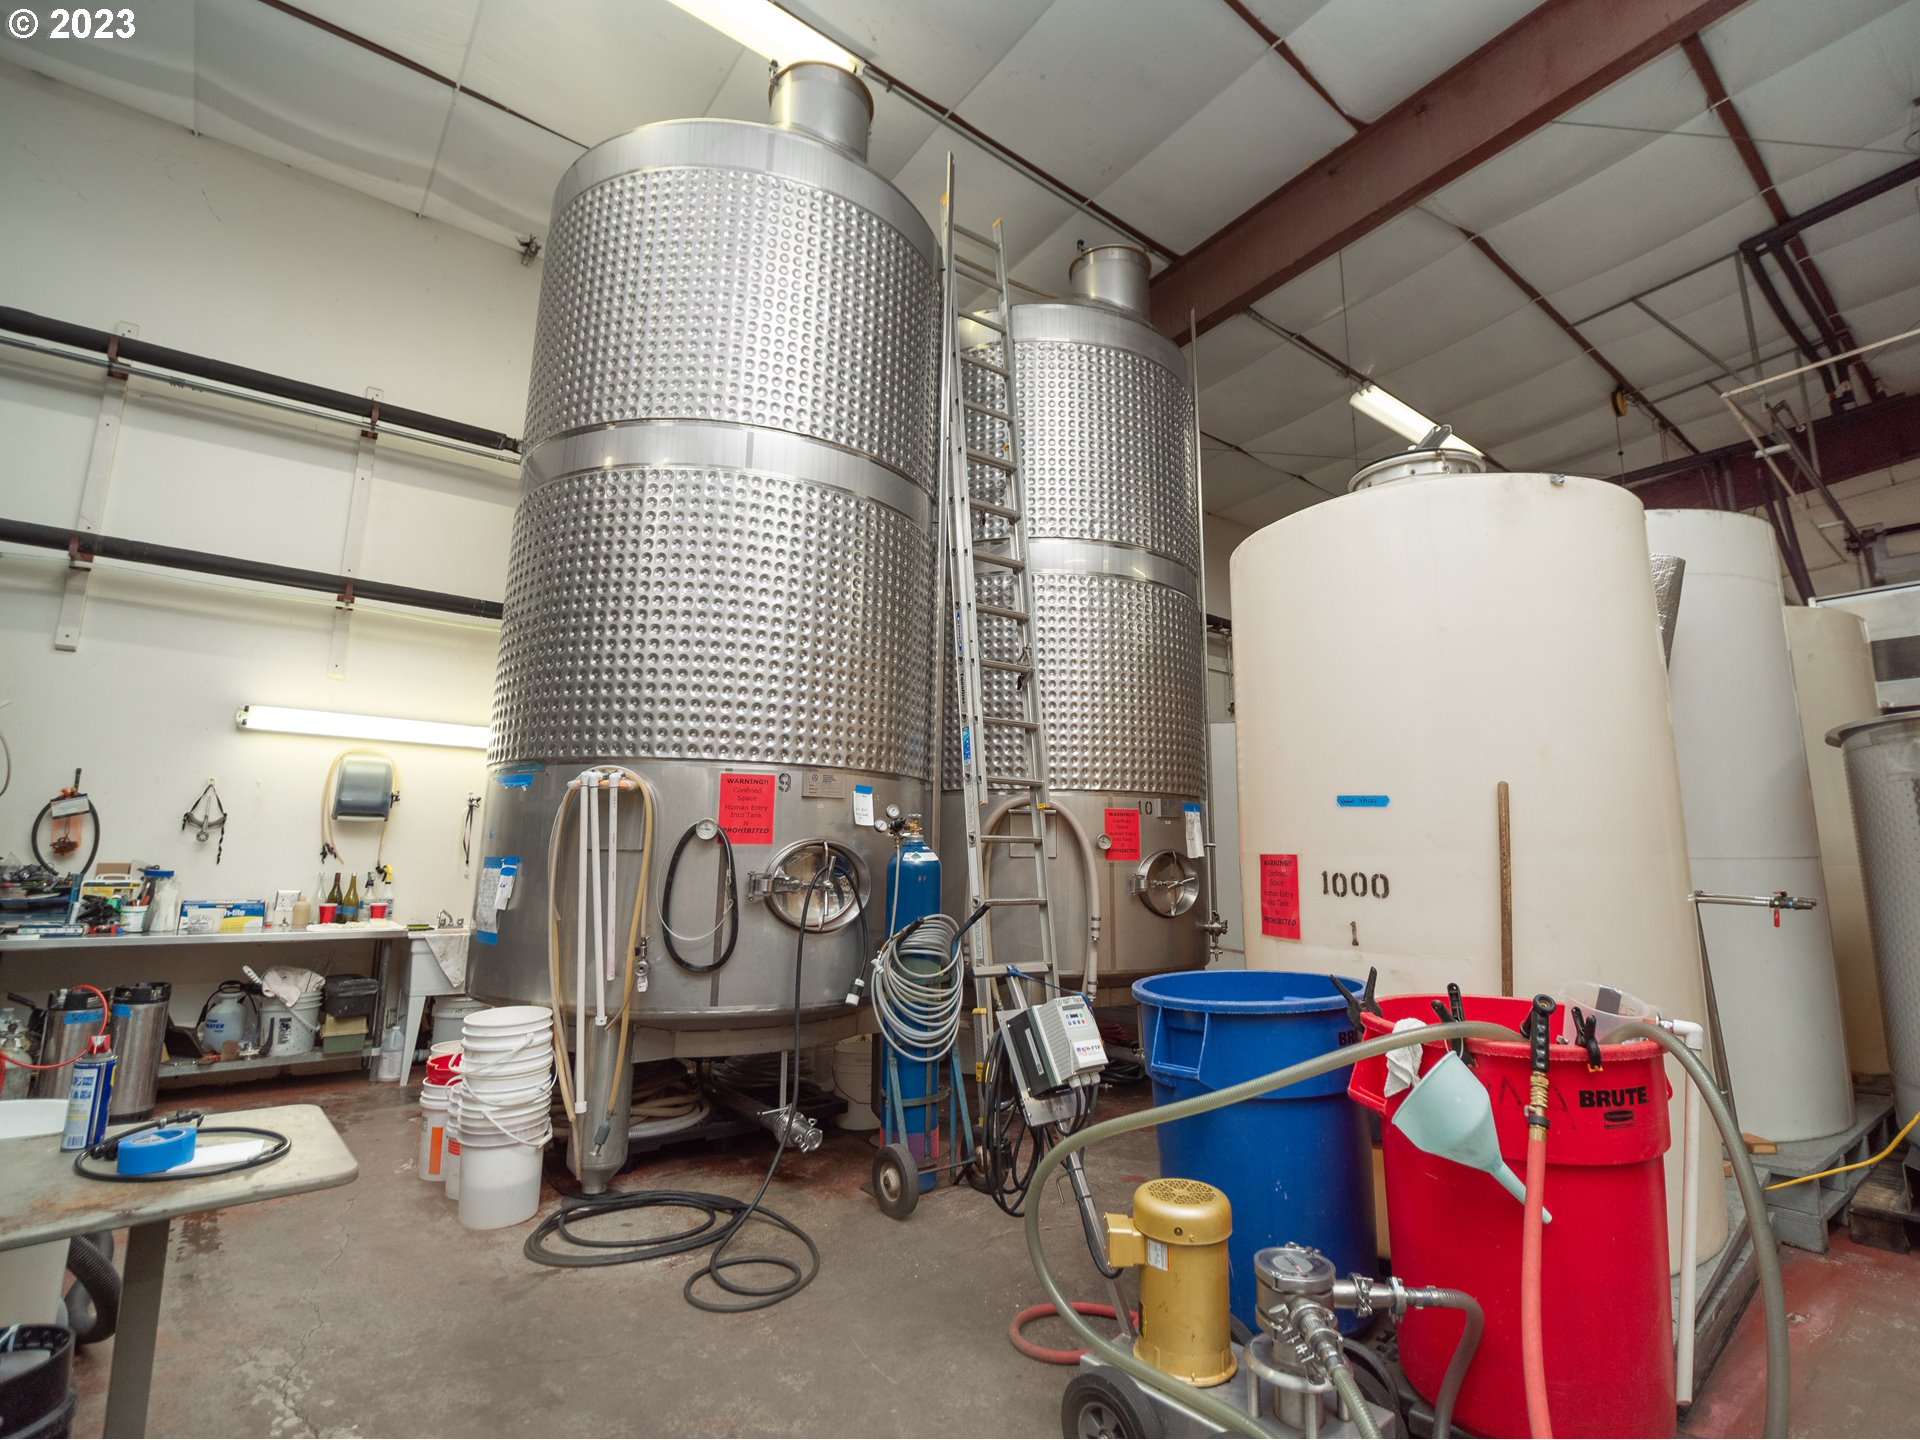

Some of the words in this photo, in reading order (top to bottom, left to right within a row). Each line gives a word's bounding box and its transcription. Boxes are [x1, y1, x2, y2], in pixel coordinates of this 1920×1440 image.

[778, 772, 792, 792] 9
[737, 794, 757, 802] Space
[751, 804, 768, 812] Entry
[1138, 801, 1153, 815] 10
[1321, 870, 1390, 899] 1000
[1350, 921, 1359, 946] 1
[1579, 1085, 1648, 1108] BRUTE
